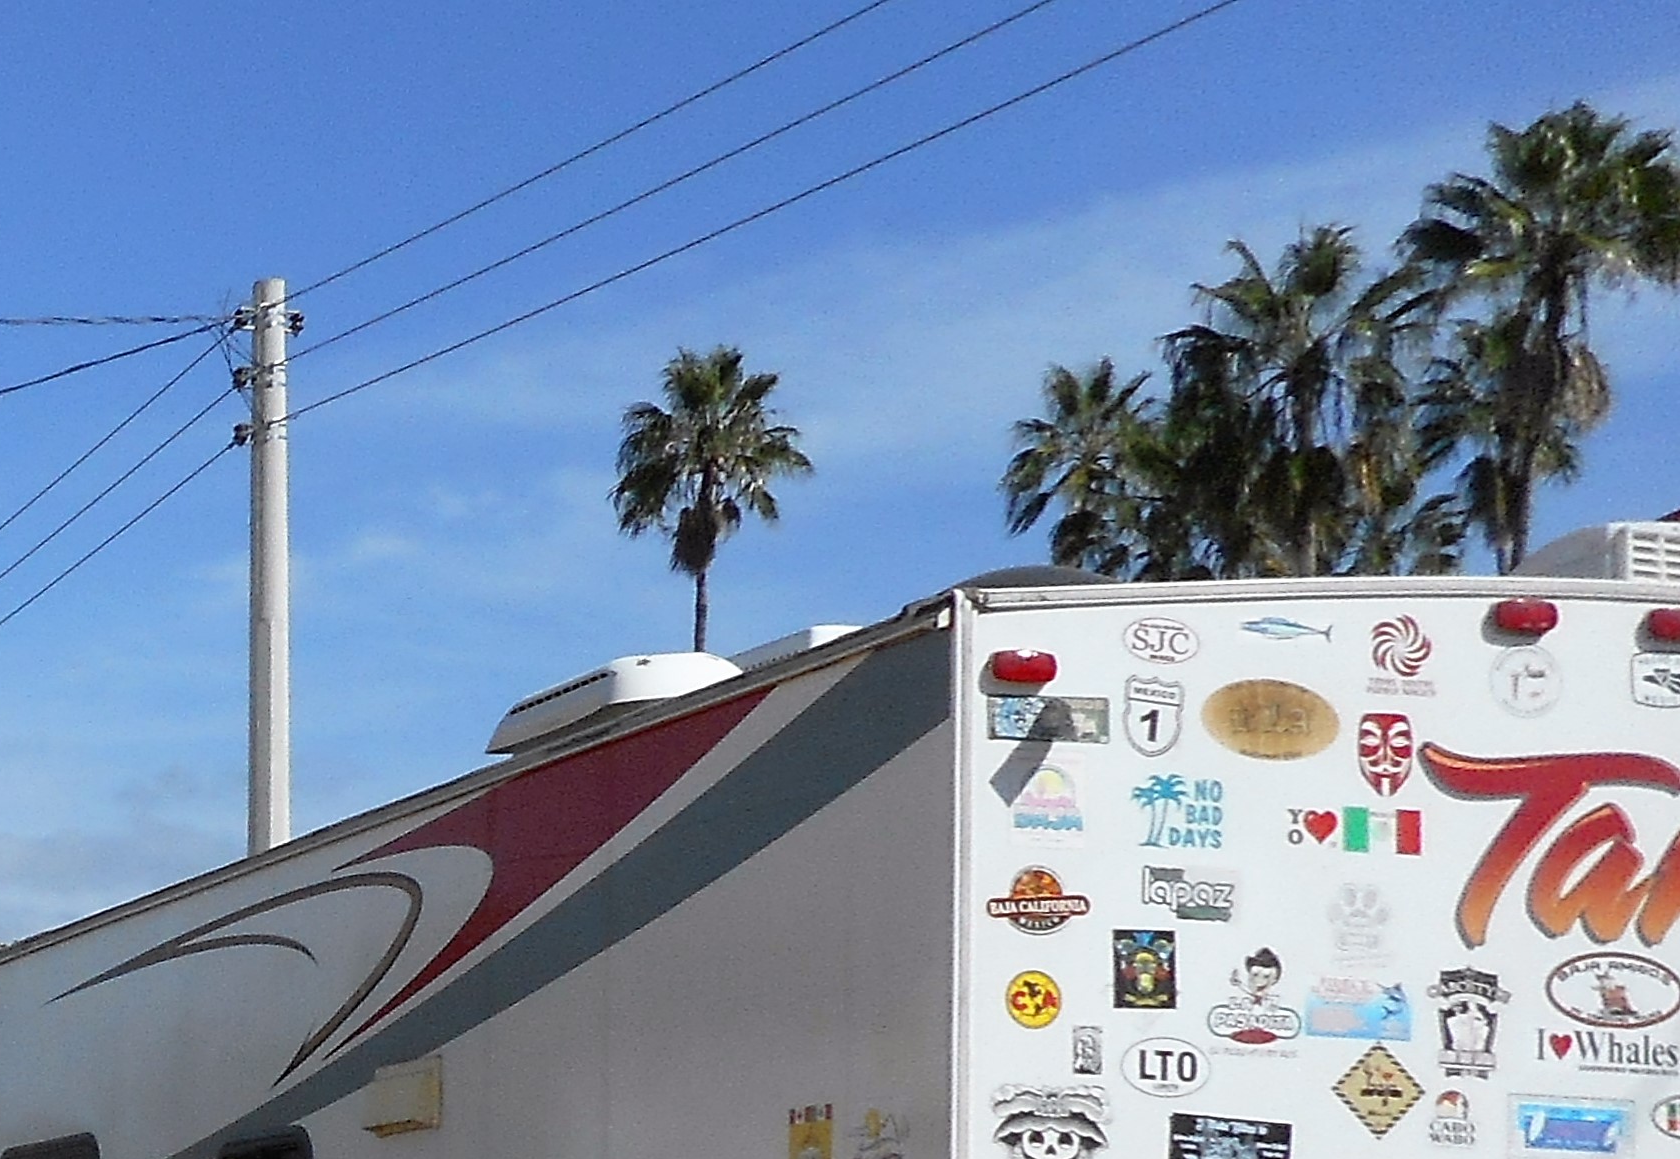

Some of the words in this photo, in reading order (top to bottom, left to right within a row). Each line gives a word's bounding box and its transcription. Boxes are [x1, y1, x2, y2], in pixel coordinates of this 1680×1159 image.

[1132, 628, 1190, 655] SJC
[1133, 686, 1177, 700] MEXICO
[1140, 709, 1160, 743] 1
[1195, 779, 1223, 803] NO
[1186, 804, 1223, 826] BAD
[1168, 828, 1223, 849] DAYS
[990, 901, 1019, 915] BAJA
[1020, 899, 1087, 915] CALIFORNIA
[1537, 1029, 1546, 1060] I
[1575, 1031, 1679, 1067] Whales
[1139, 1050, 1198, 1083] LTO
